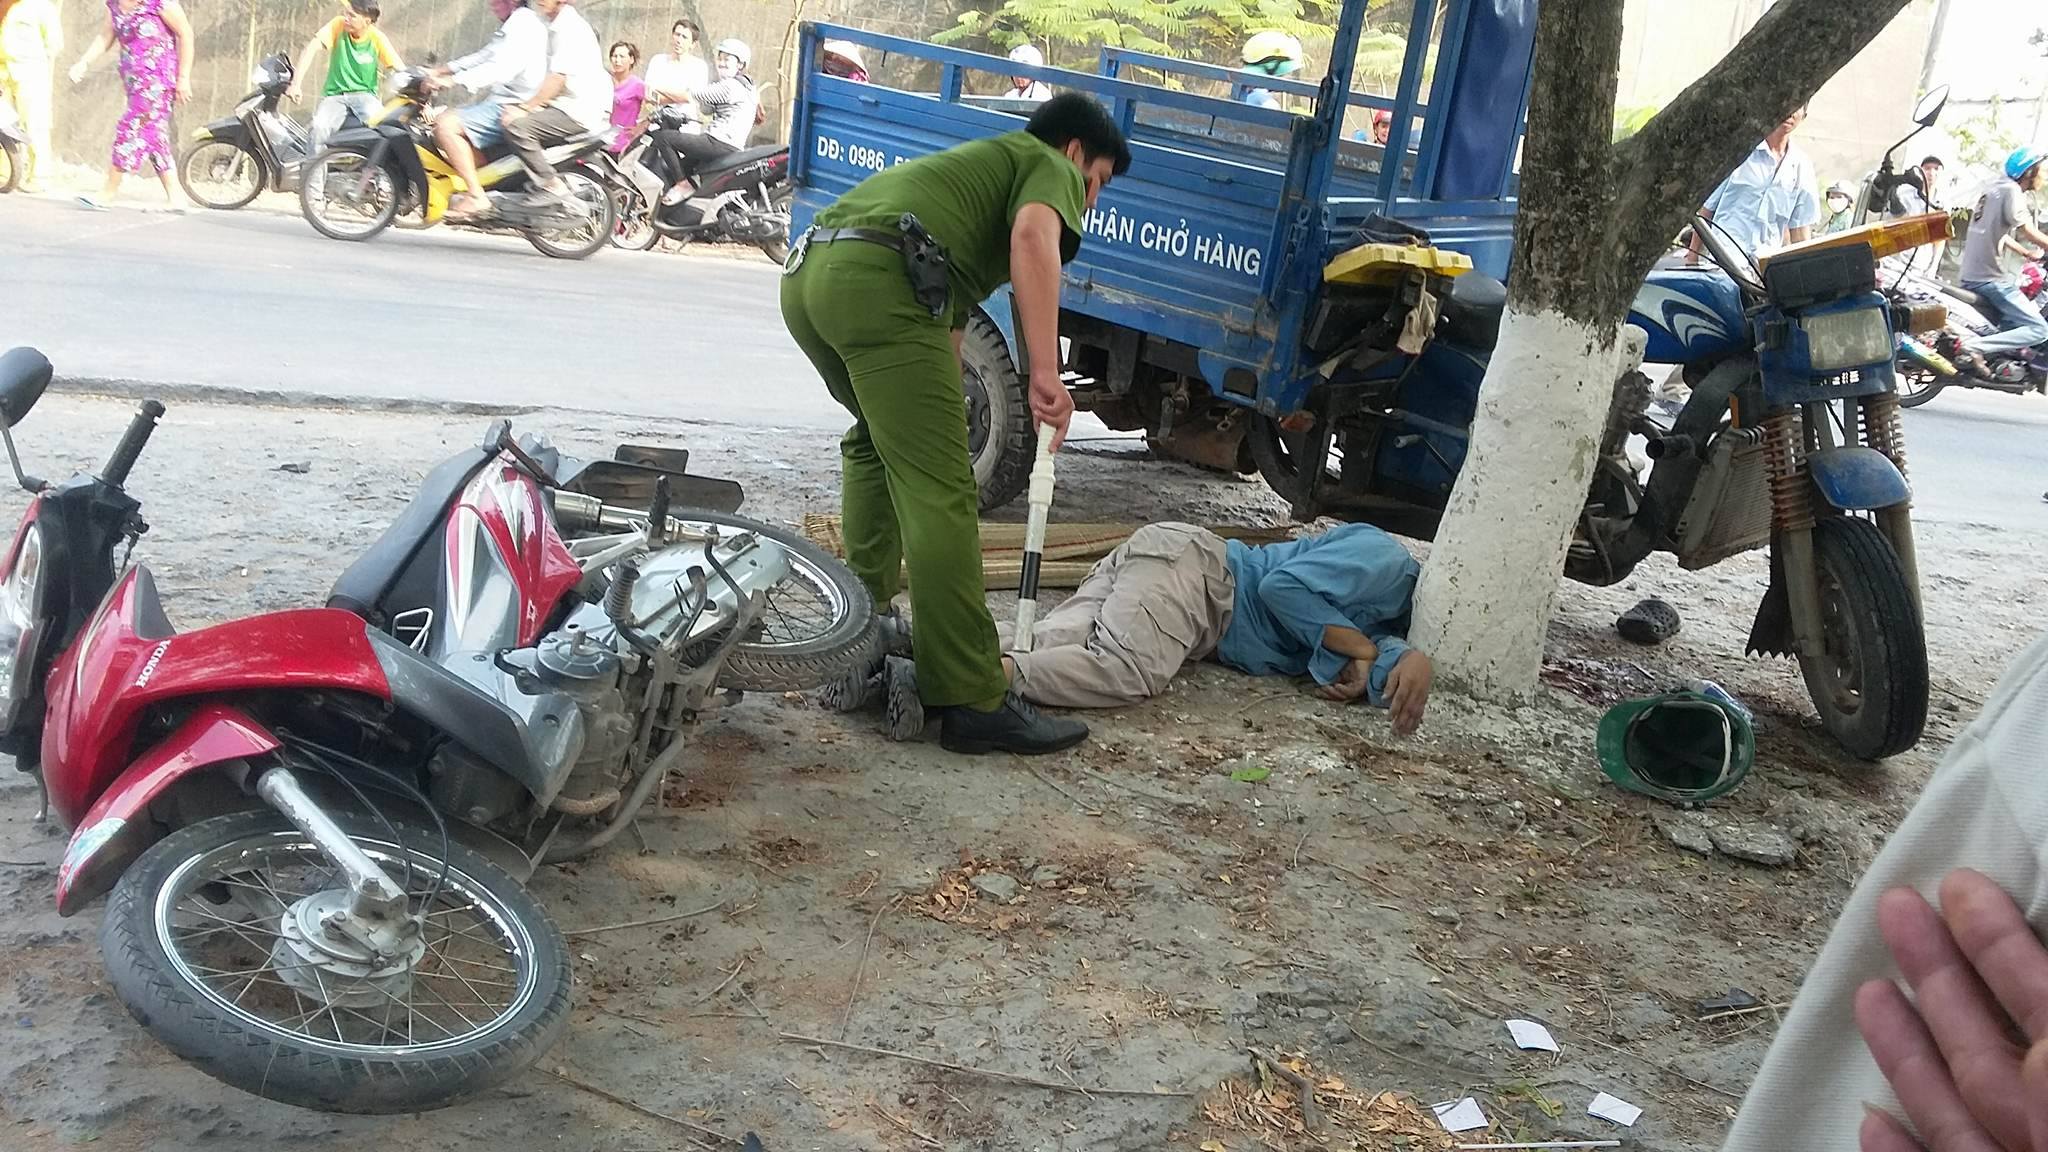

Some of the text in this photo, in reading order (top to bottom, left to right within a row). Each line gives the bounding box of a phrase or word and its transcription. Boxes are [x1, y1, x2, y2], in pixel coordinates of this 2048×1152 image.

[817, 135, 845, 162] DĐ:
[1140, 218, 1190, 257] CHỞ
[1193, 233, 1262, 276] HÀNG
[135, 639, 172, 688] HONDA
